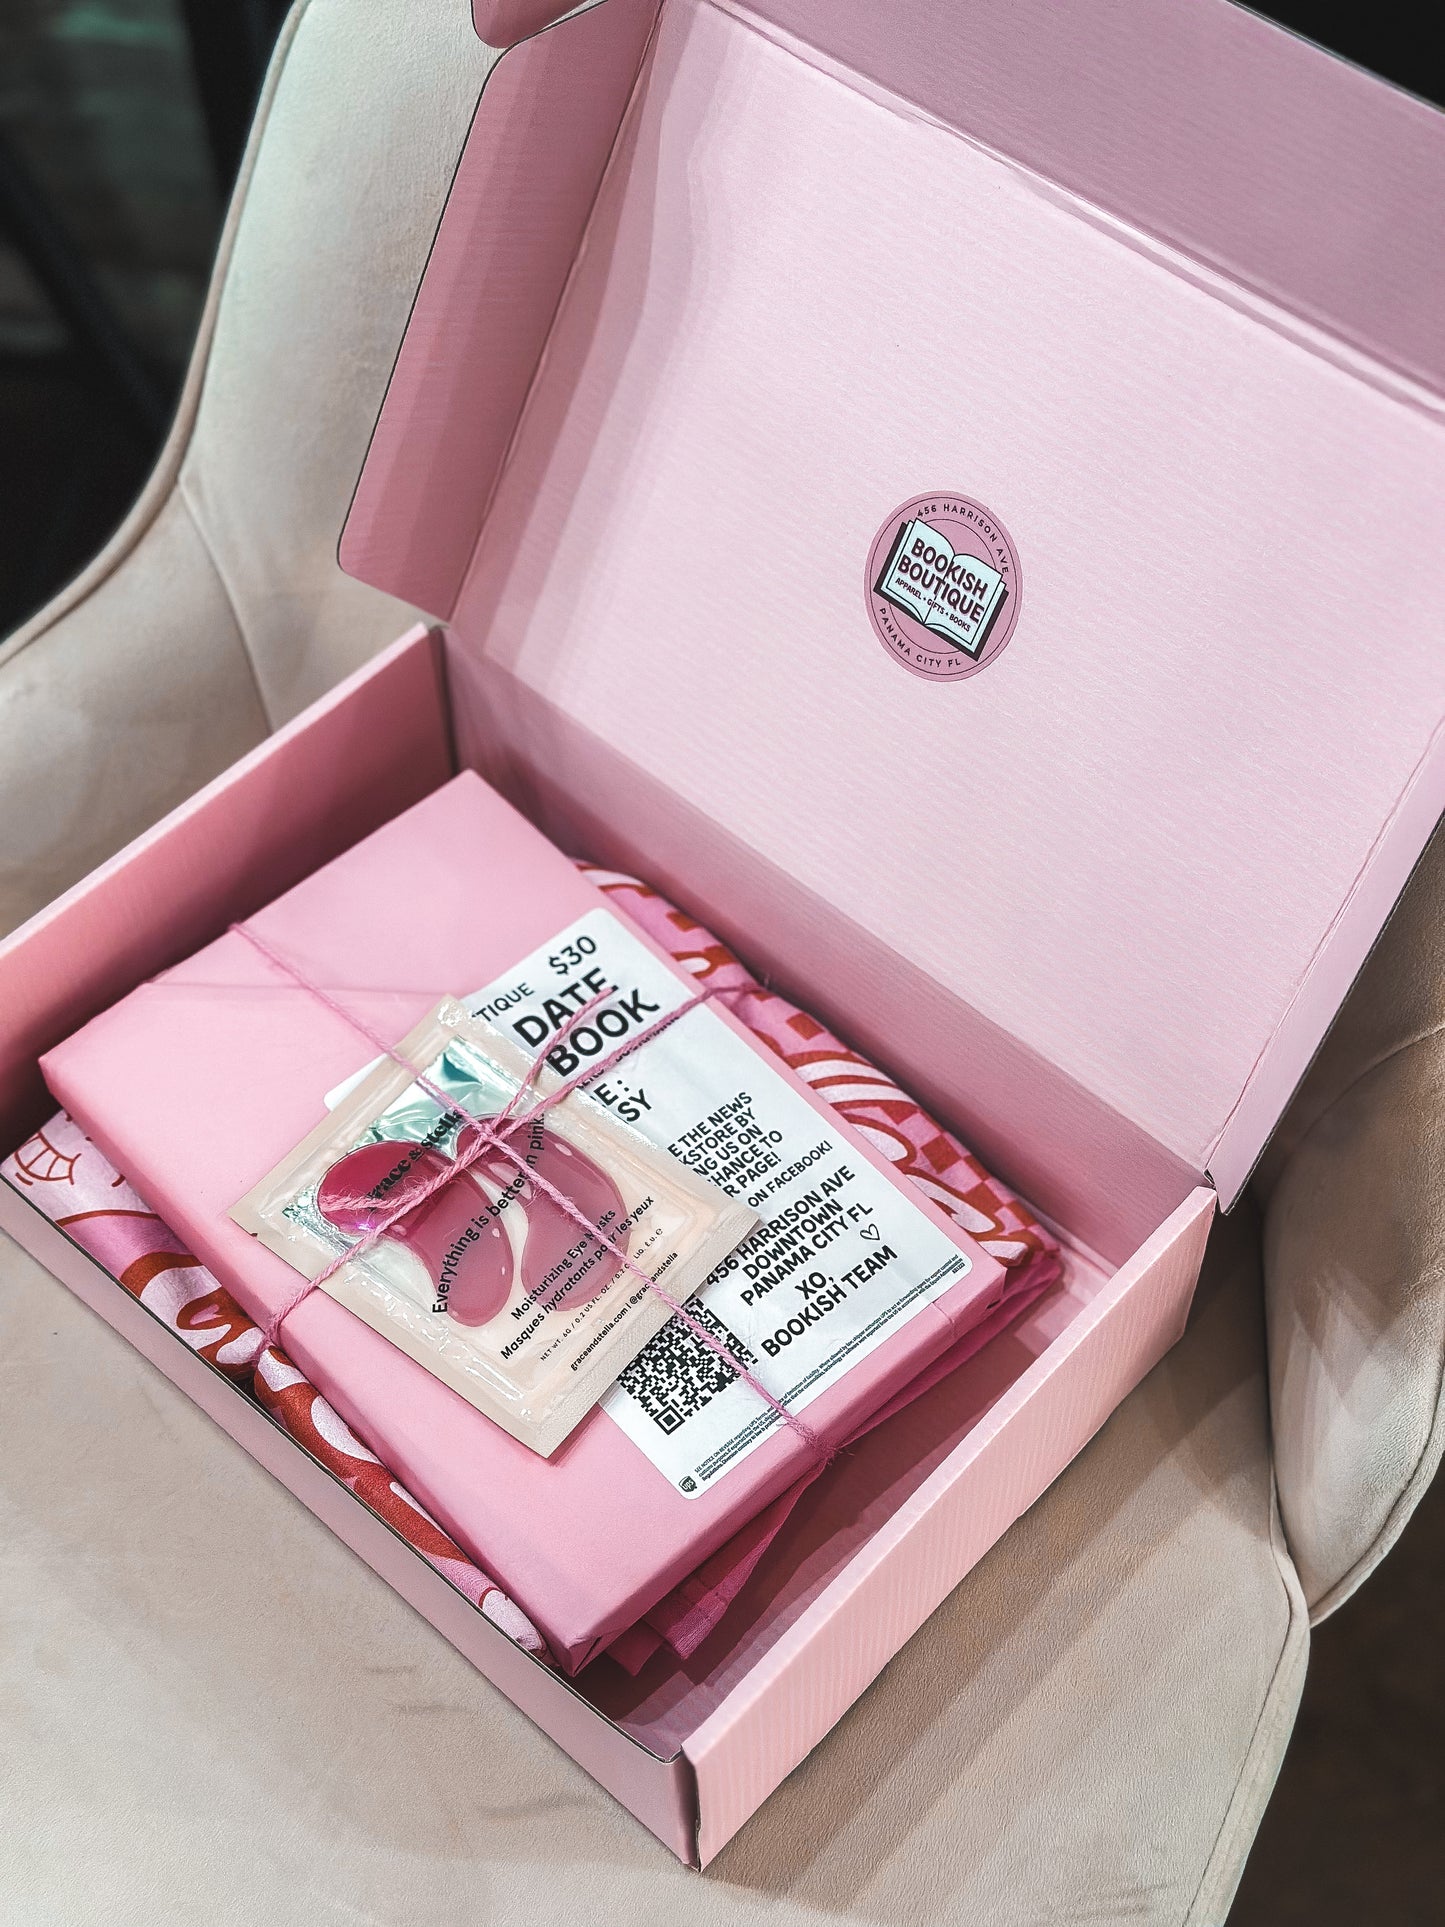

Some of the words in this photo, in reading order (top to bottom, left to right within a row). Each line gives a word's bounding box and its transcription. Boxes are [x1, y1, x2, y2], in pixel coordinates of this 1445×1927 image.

[910, 537, 988, 600] BOOKISH
[917, 504, 937, 518] 456
[943, 503, 998, 543] HARRISON
[996, 547, 1010, 574] AVE
[895, 578, 922, 600] APPAREL
[926, 599, 945, 614] GIFTS
[949, 613, 972, 632] BOOKS
[897, 554, 986, 624] BOUTIQUE
[879, 607, 912, 656] PANAMA
[916, 654, 942, 668] CITY
[948, 658, 961, 668] FL
[549, 936, 597, 975] $30
[471, 982, 535, 1022] TIQUE
[512, 967, 619, 1048] DATE
[545, 988, 661, 1077] BOOK
[617, 1088, 652, 1122] SY
[677, 1121, 711, 1148] THE
[708, 1091, 753, 1128] NEWS
[678, 1122, 739, 1166] KSTORE
[735, 1107, 756, 1132] BY
[692, 1158, 718, 1178] NG
[720, 1142, 739, 1161] US
[737, 1124, 764, 1146] ON
[707, 1147, 764, 1188] HANCE
[758, 1130, 783, 1152] TO
[736, 1151, 783, 1190] PAGE!
[747, 1190, 769, 1208] ON
[766, 1140, 834, 1194] FACEBOOK!
[365, 1158, 412, 1211] race
[432, 1226, 481, 1314] Everything
[472, 1213, 490, 1231] is
[486, 1170, 531, 1218] better
[528, 1113, 545, 1151] pink.
[706, 1252, 740, 1287] 456
[735, 1190, 821, 1261] HARRISON
[818, 1164, 856, 1197] AVE
[740, 1244, 817, 1307] PANAMA
[812, 1219, 850, 1251] CITY
[846, 1201, 875, 1224] FL
[742, 1198, 844, 1280] DOWNTOWN
[500, 1316, 545, 1360] Masques
[542, 1257, 596, 1312] hydratants
[614, 1218, 633, 1235] les
[630, 1196, 656, 1224] yeux
[510, 1258, 573, 1321] Moisturizing
[567, 1239, 589, 1260] Eye
[760, 1283, 848, 1357] BOOKISH
[841, 1243, 898, 1292] TEAM
[794, 1270, 835, 1301] XO,
[540, 1349, 552, 1362] NET
[584, 1302, 594, 1313] US
[570, 1308, 629, 1372] graceandstella.com
[629, 1251, 679, 1306] @gracandstella
